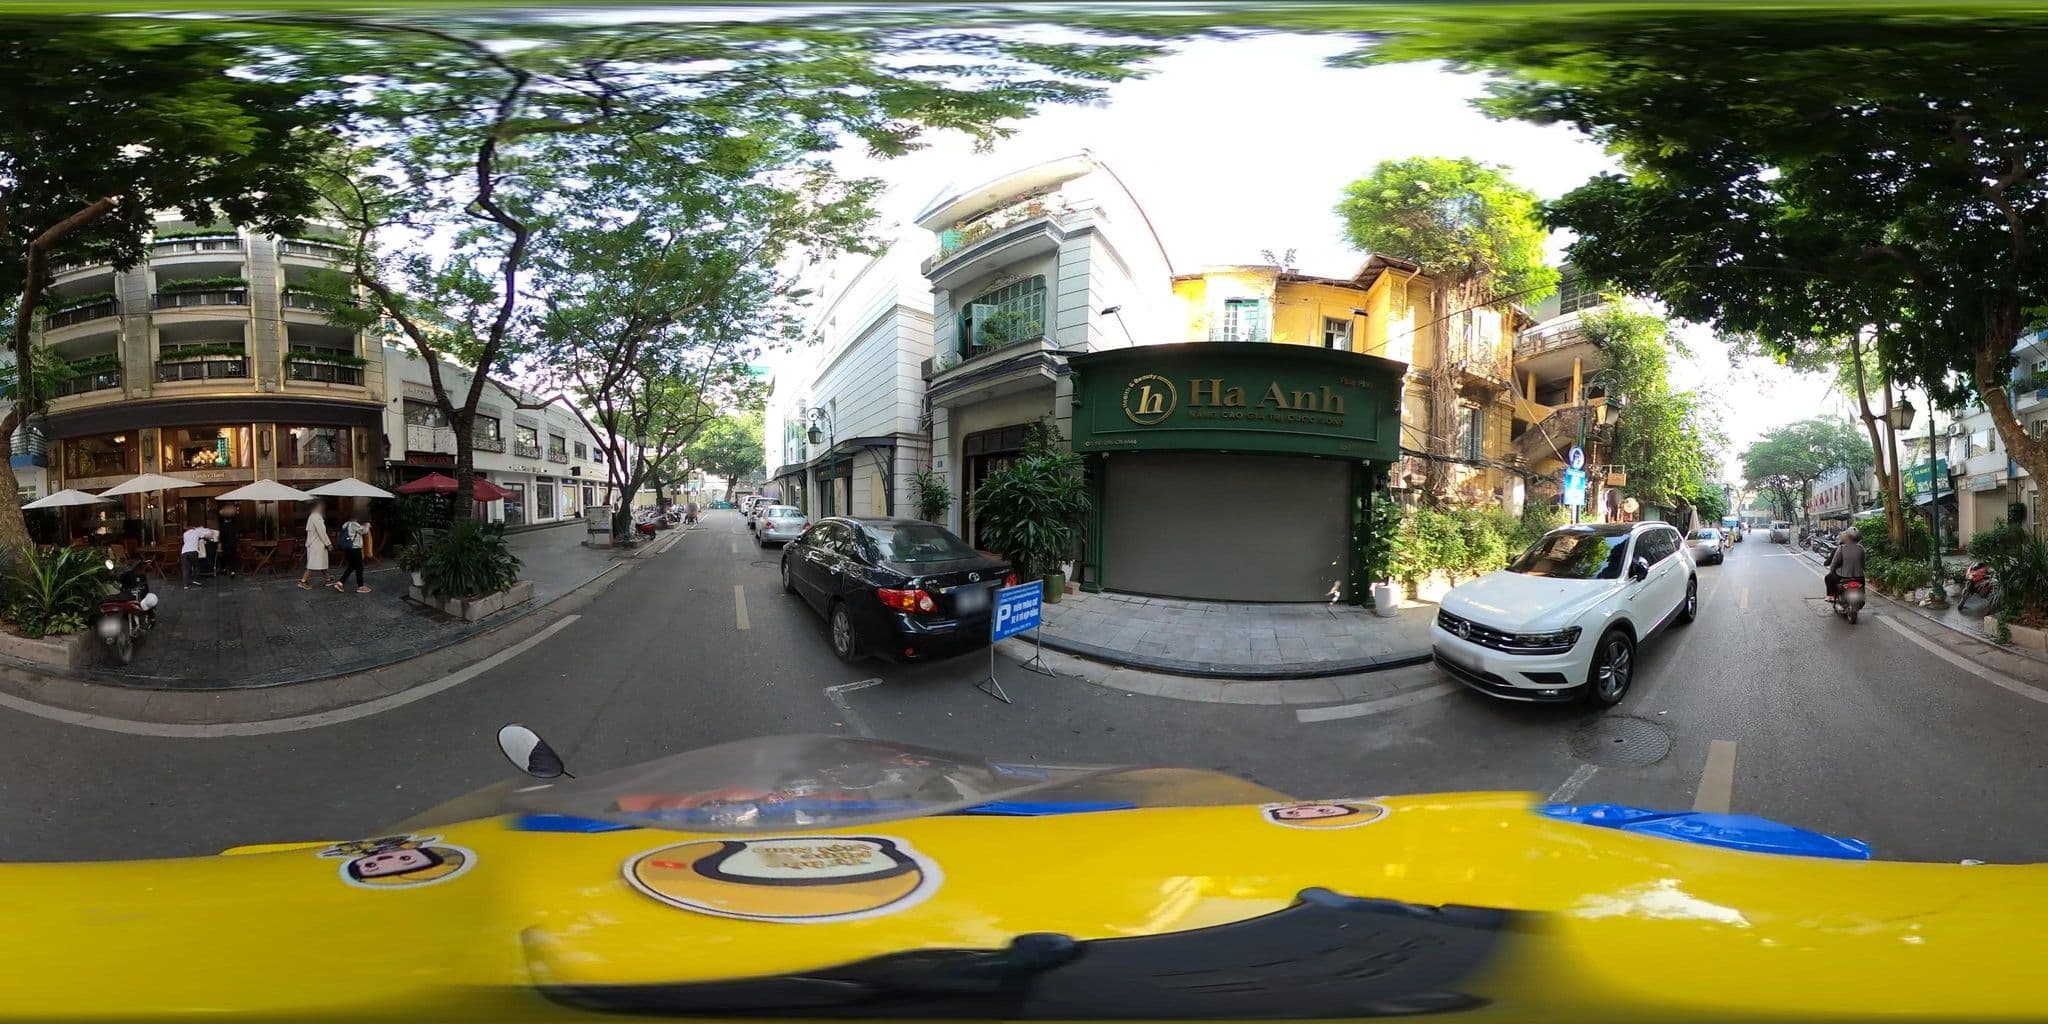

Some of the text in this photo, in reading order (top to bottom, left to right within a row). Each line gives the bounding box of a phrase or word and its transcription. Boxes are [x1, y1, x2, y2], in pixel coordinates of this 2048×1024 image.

[1135, 385, 1163, 415] h
[1186, 378, 1247, 407] Ha
[1256, 380, 1345, 414] Anh
[995, 603, 1012, 632] P
